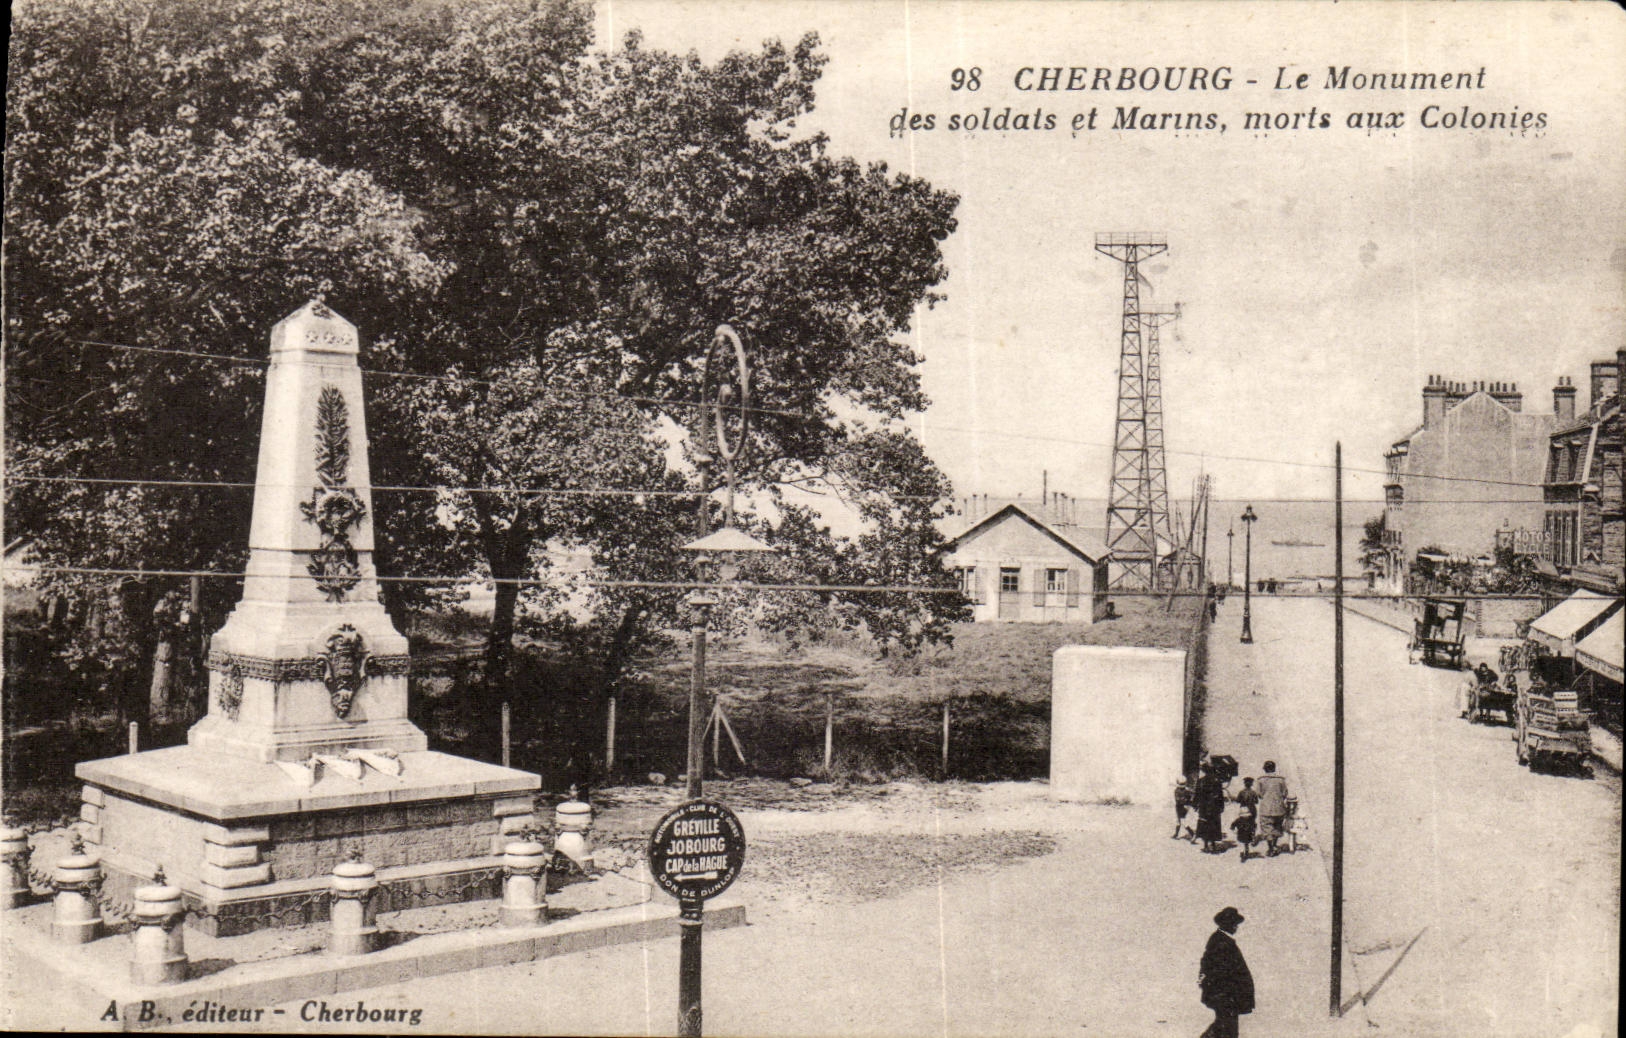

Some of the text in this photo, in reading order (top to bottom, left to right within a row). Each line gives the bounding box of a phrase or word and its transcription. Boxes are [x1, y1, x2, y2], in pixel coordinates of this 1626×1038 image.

[1514, 531, 1551, 542] MOTOS
[709, 806, 718, 814] DE
[673, 818, 720, 837] GRÉVILLE
[666, 837, 726, 856] JOBOURG
[665, 855, 729, 874] CAP de la HAGUE
[659, 866, 735, 898] DON DE DUNLOP
